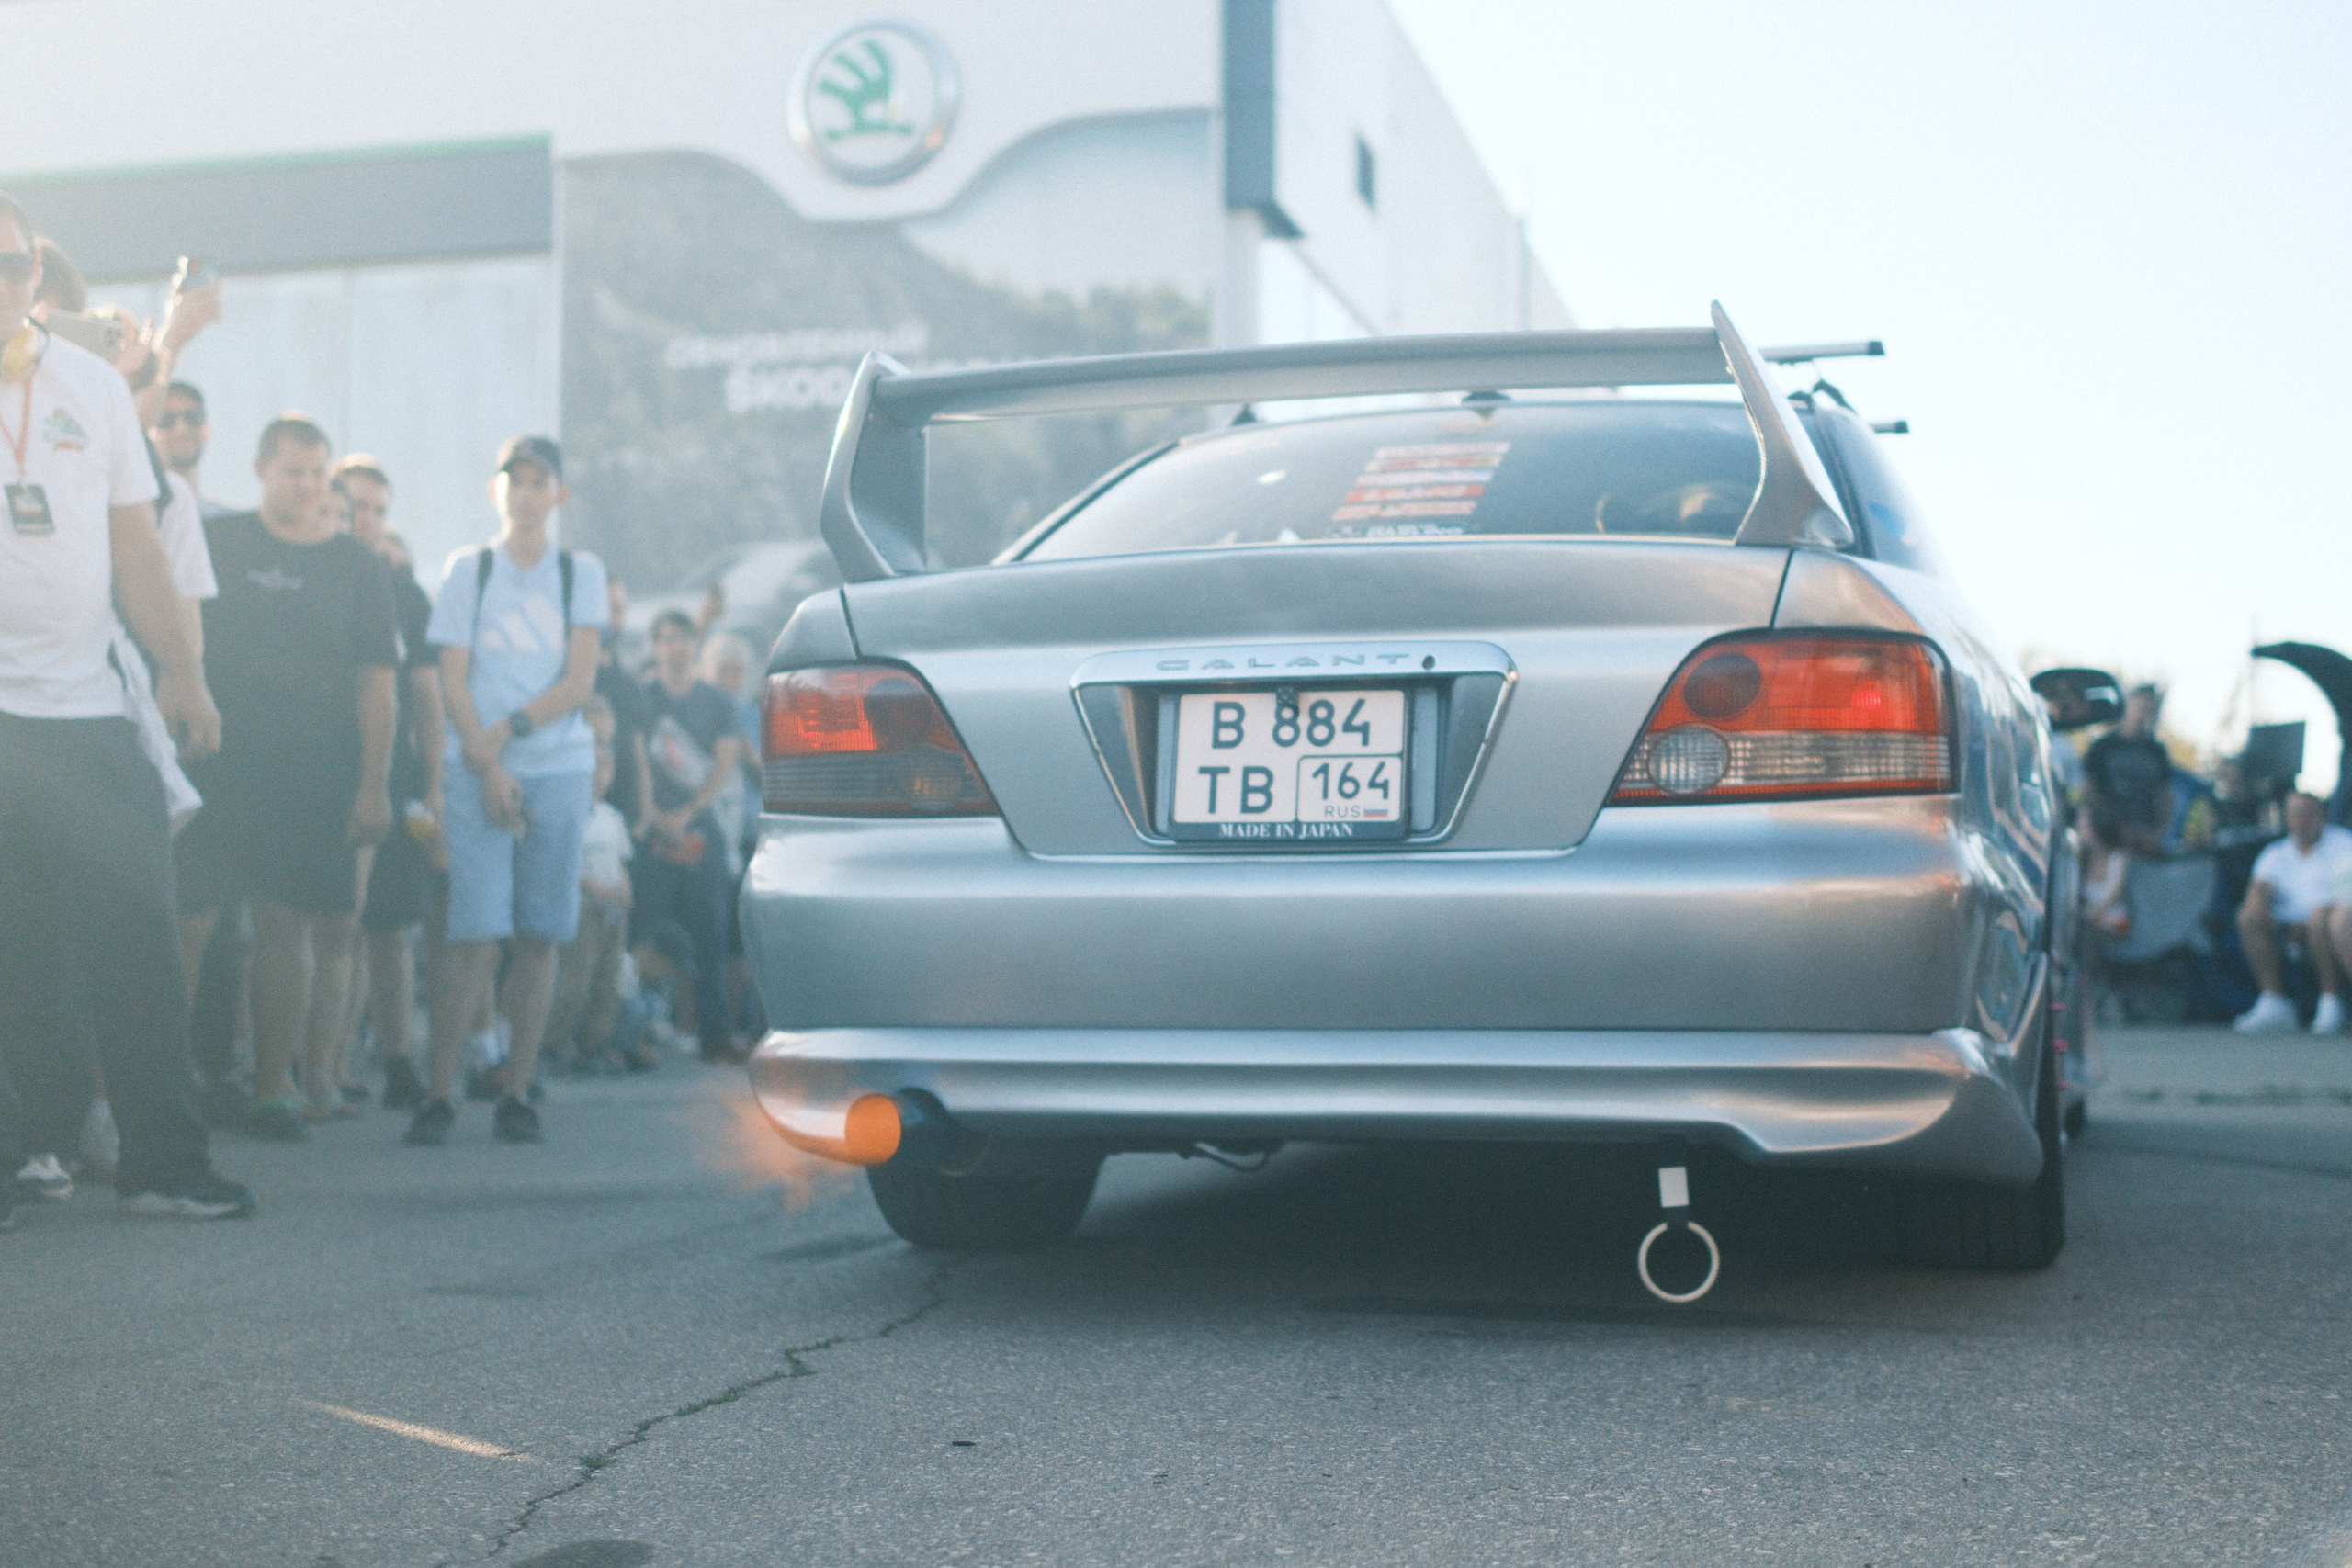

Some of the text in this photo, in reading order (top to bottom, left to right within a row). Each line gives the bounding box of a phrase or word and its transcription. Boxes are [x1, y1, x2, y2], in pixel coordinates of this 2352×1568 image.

[1156, 653, 1409, 671] GALANT
[1211, 698, 1371, 750] B 884
[1198, 761, 1389, 814] TB 164
[1325, 805, 1361, 818] RUS
[1219, 823, 1353, 839] MADE IN JAPAN
